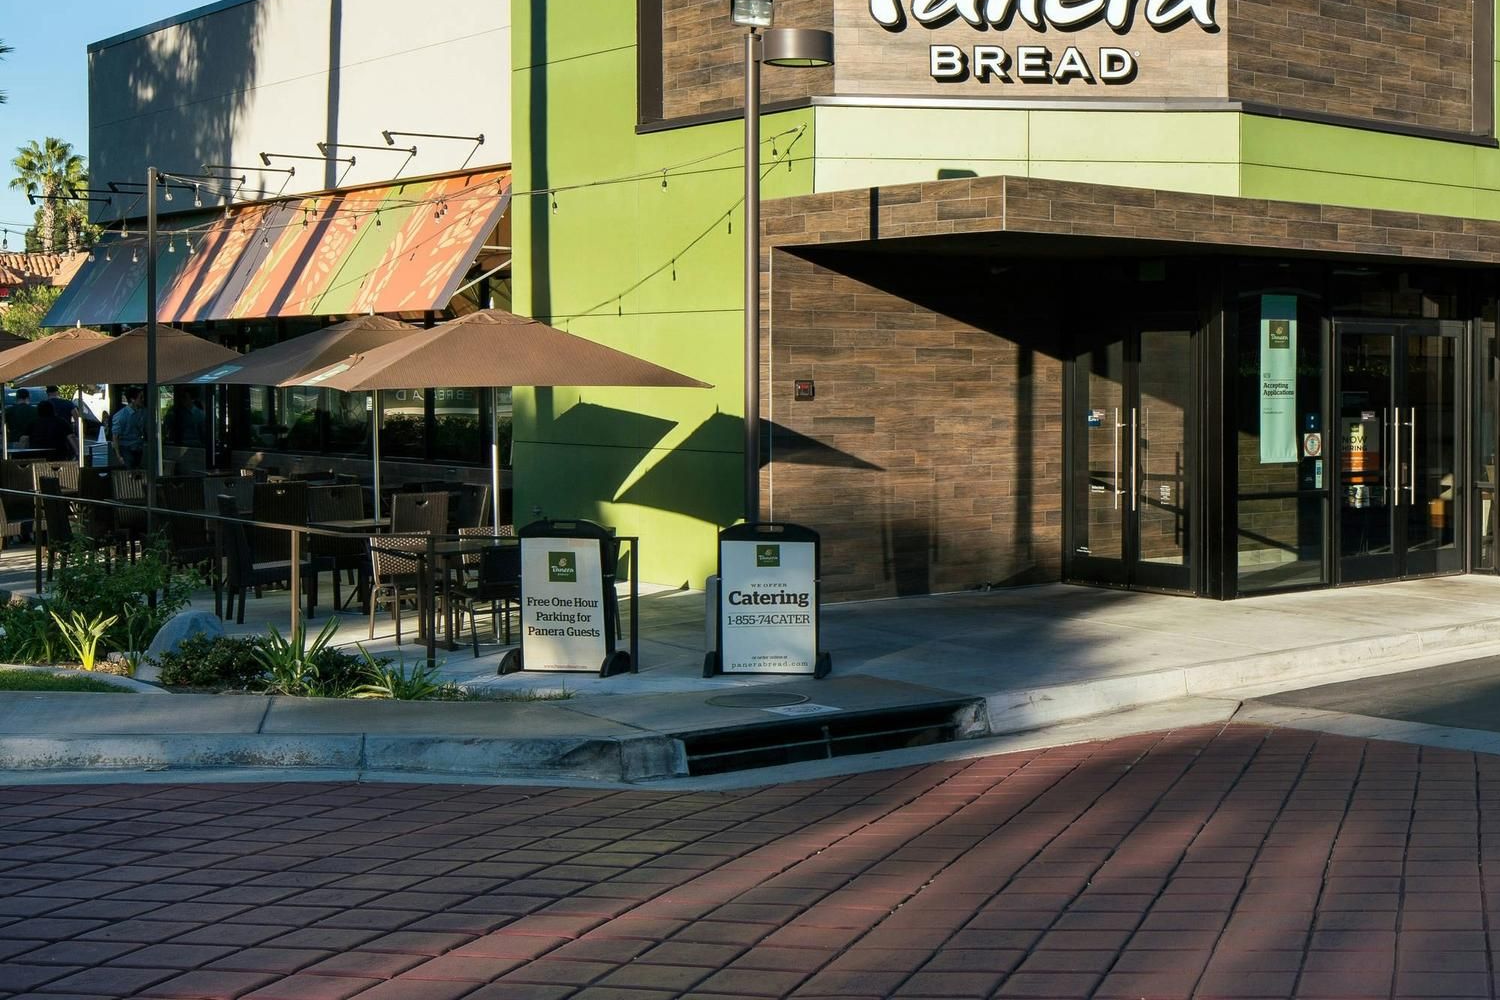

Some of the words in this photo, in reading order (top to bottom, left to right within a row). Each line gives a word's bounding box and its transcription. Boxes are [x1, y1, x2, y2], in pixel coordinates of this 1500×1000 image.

[929, 44, 1136, 82] BREAD
[527, 597, 550, 607] Free
[551, 596, 572, 608] One
[574, 597, 599, 608] Hour
[728, 590, 810, 608] Catering
[536, 611, 576, 623] Parking
[577, 612, 592, 623] for
[727, 614, 811, 625] 1-855-74CATER
[527, 626, 565, 637] Panera
[566, 626, 601, 638] Guests
[731, 660, 809, 669] panerabread.com
